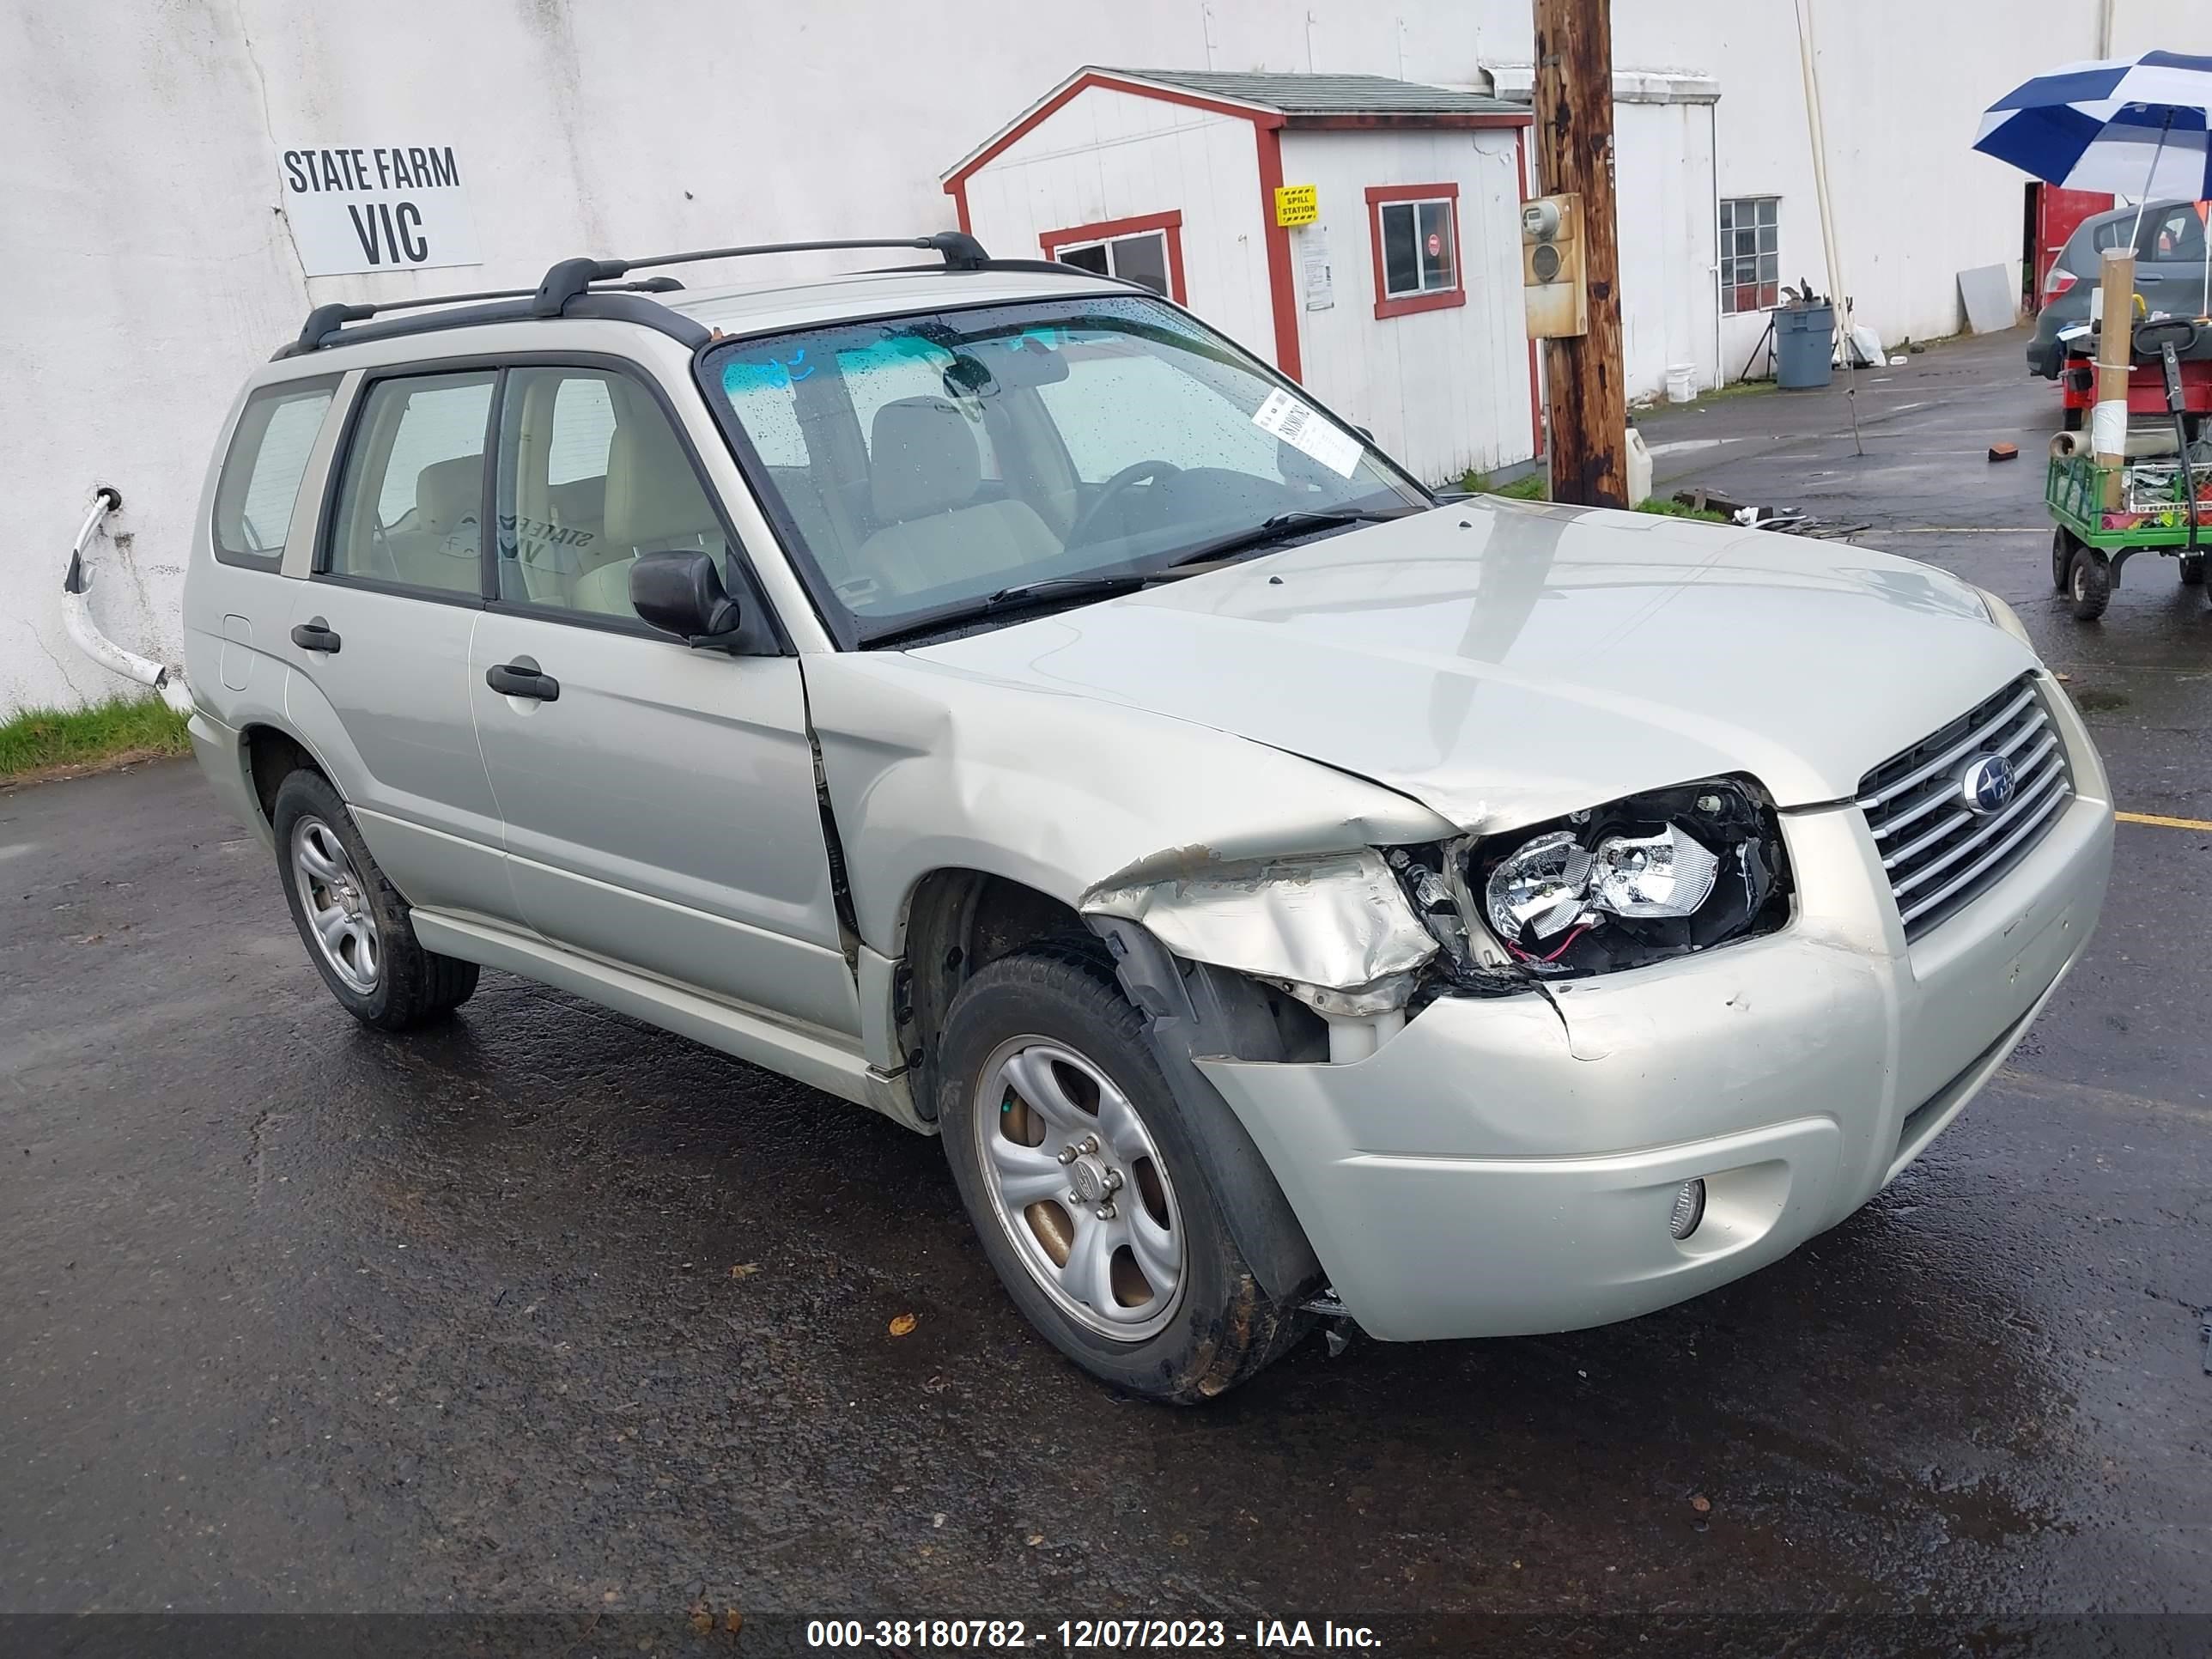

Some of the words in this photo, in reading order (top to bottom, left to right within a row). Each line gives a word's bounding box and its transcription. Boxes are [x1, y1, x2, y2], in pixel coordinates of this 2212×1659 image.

[284, 149, 373, 193] STATE
[373, 147, 460, 190] FARM
[1282, 205, 1316, 216] STATION
[1287, 196, 1310, 205] SPILL
[347, 202, 428, 265] VIC
[1279, 404, 1310, 440] 38180782
